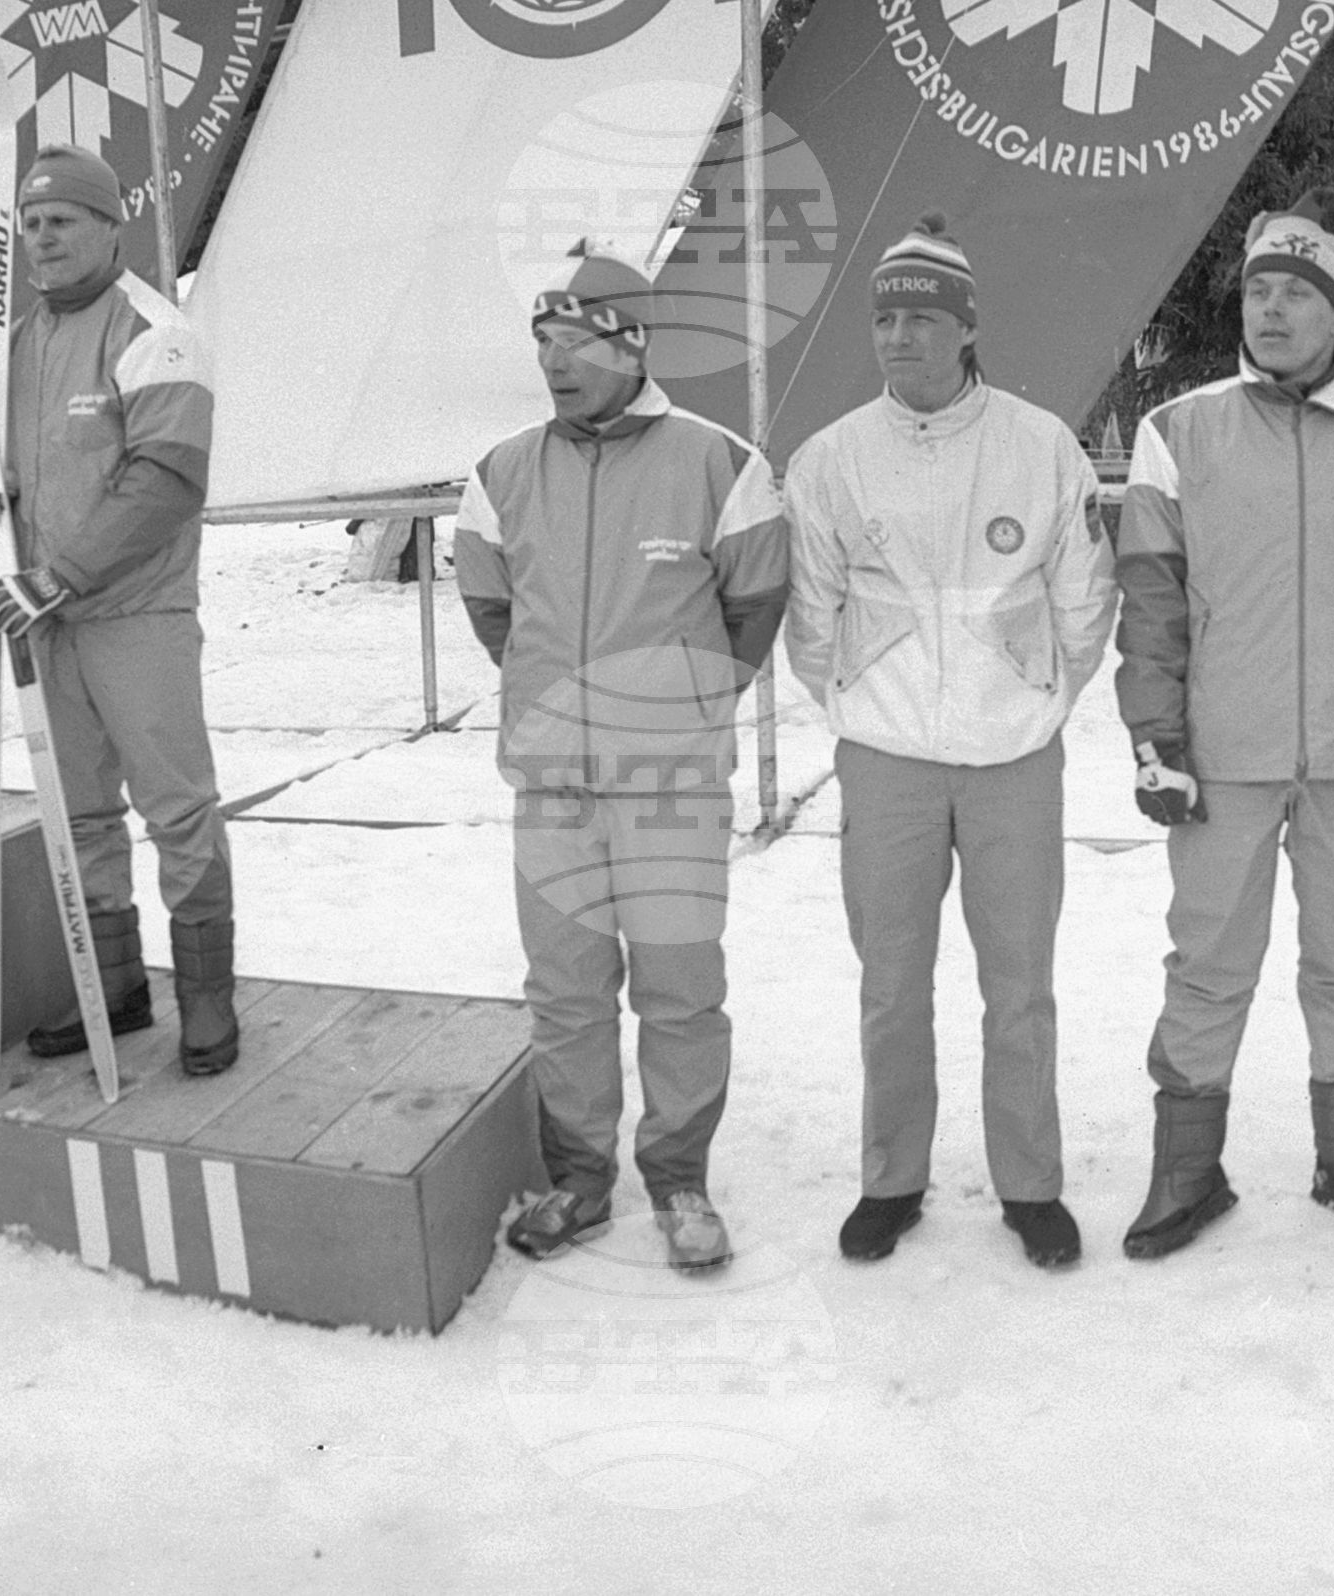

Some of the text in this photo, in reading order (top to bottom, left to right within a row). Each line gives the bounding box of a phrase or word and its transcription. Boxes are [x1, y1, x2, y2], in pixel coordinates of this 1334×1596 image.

[28, 0, 110, 48] WM
[877, 0, 952, 101] SECHS
[936, 88, 1241, 178] BULGARIEN 1986
[875, 276, 940, 295] SVERIGE
[57, 871, 88, 954] MATRIX
